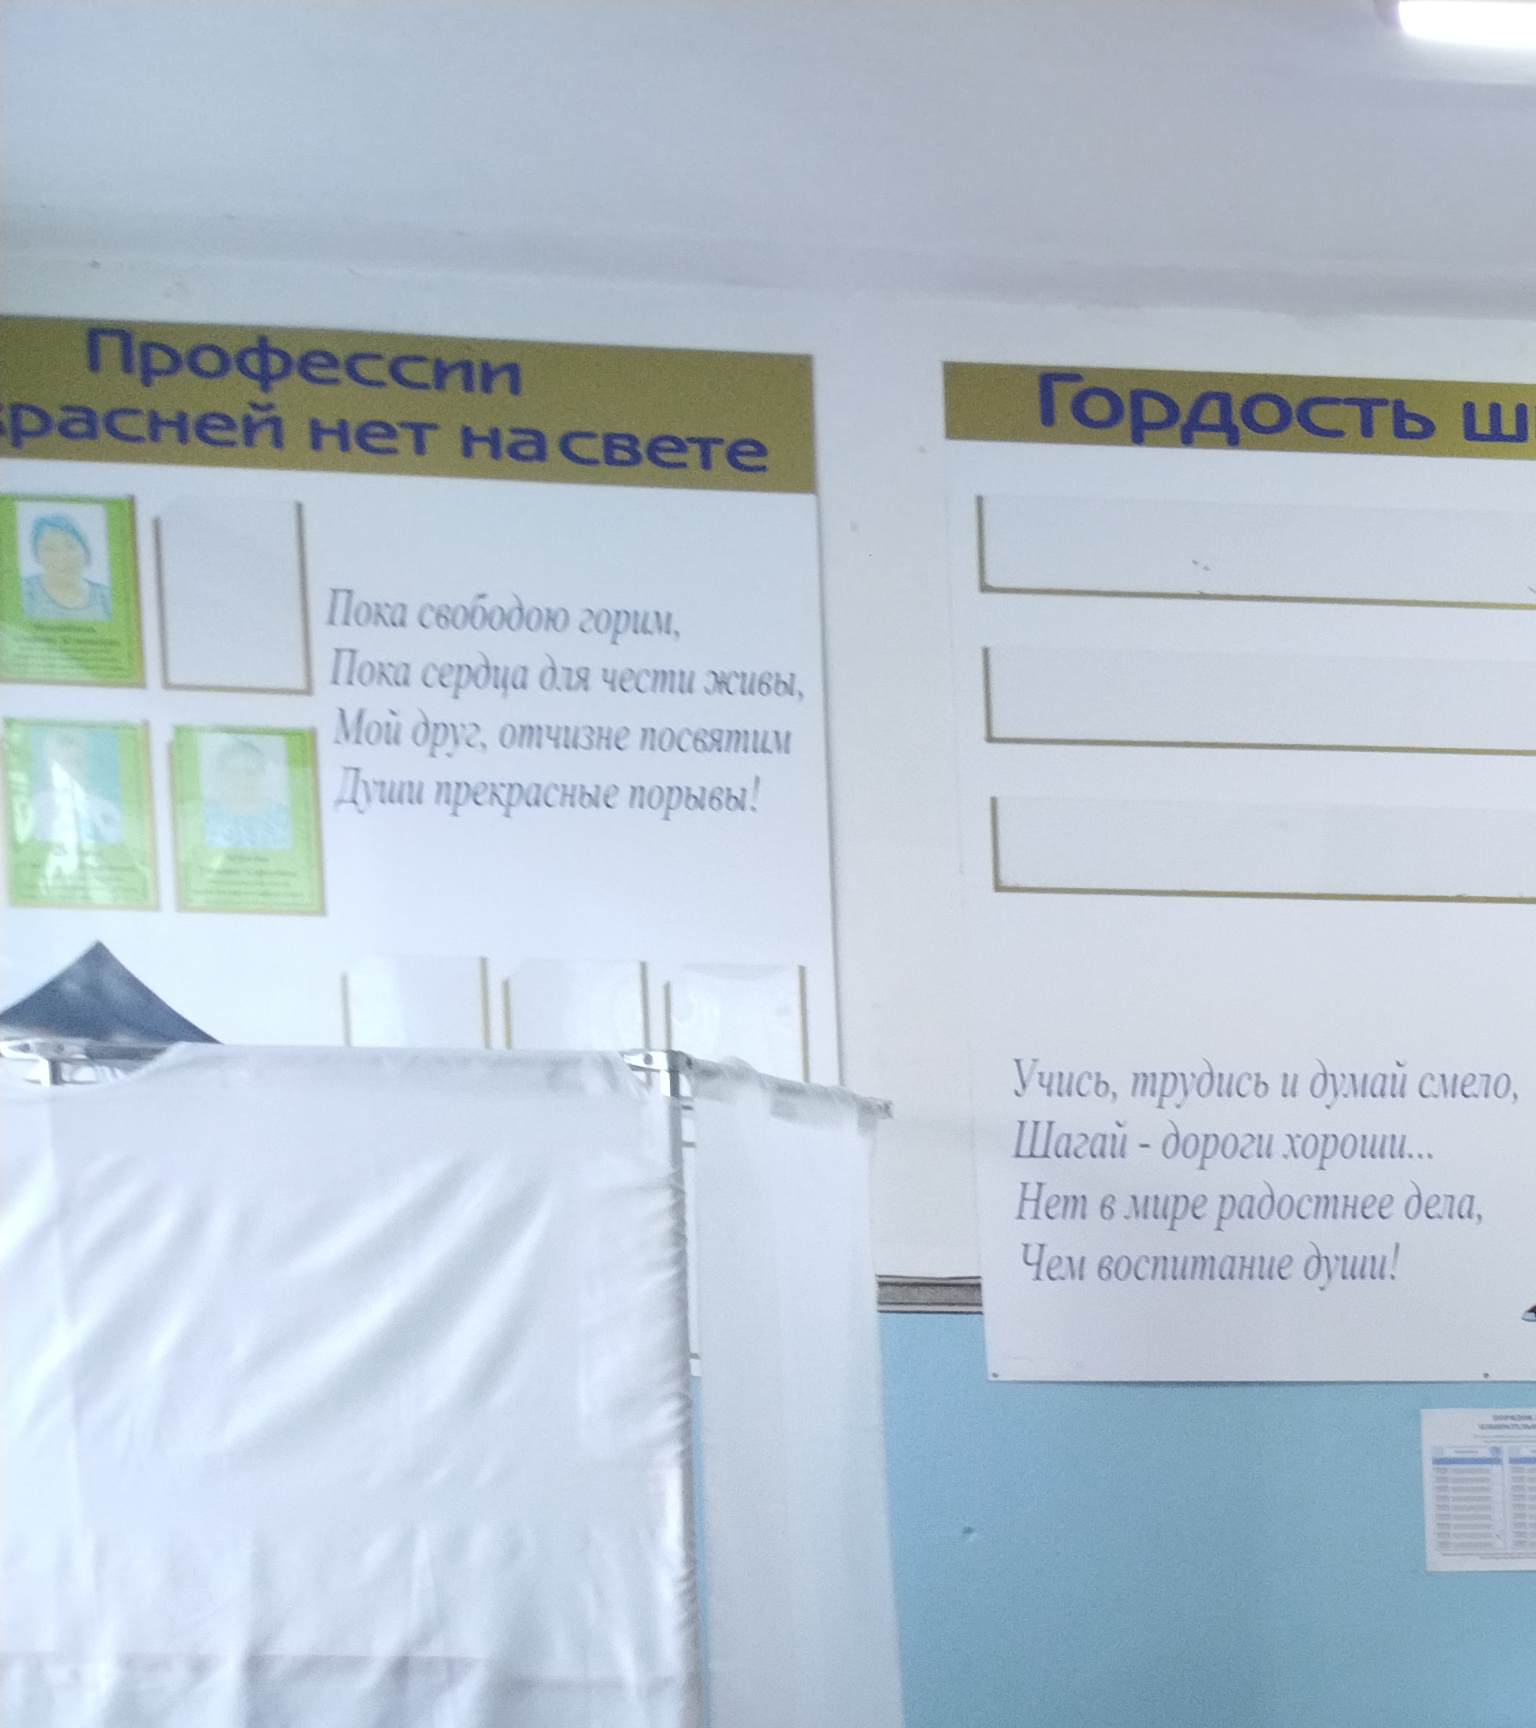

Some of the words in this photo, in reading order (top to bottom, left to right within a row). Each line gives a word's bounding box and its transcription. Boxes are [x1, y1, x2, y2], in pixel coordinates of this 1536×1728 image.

[87, 327, 521, 396] Профессии
[1038, 372, 1436, 446] Гордость
[0, 402, 284, 450] расней
[309, 417, 439, 456] нет
[460, 424, 547, 463] на
[558, 430, 769, 474] свете
[325, 588, 408, 628] Пока
[417, 592, 570, 633] свободою
[578, 607, 680, 645] горим,
[330, 647, 411, 687] Пока
[421, 650, 529, 700] сердца
[538, 652, 591, 692] для
[602, 667, 696, 694] чести
[703, 669, 804, 702] живы,
[333, 707, 402, 746] Мой
[411, 707, 487, 758] друг,
[499, 722, 631, 751] отчизне
[639, 726, 792, 755] посвятим
[334, 766, 425, 814] Души
[434, 780, 620, 818] прекрасные
[628, 774, 761, 821] порывы!
[1012, 1058, 1118, 1104] Учись,
[1130, 1057, 1269, 1110] трудись
[1280, 1072, 1300, 1099] и
[1309, 1058, 1409, 1110] думай
[1418, 1071, 1519, 1105] смело,
[1011, 1119, 1129, 1160] Шагай
[1161, 1118, 1274, 1171] дороги
[1282, 1132, 1434, 1171] хороши...
[1014, 1181, 1088, 1221] Нет
[1100, 1193, 1117, 1221] в
[1123, 1193, 1209, 1232] мире
[1214, 1179, 1395, 1232] радостнее
[1404, 1179, 1483, 1226] дела,
[1021, 1242, 1086, 1281] Чем
[1097, 1254, 1294, 1281] воспитание
[1303, 1240, 1400, 1291] души!
